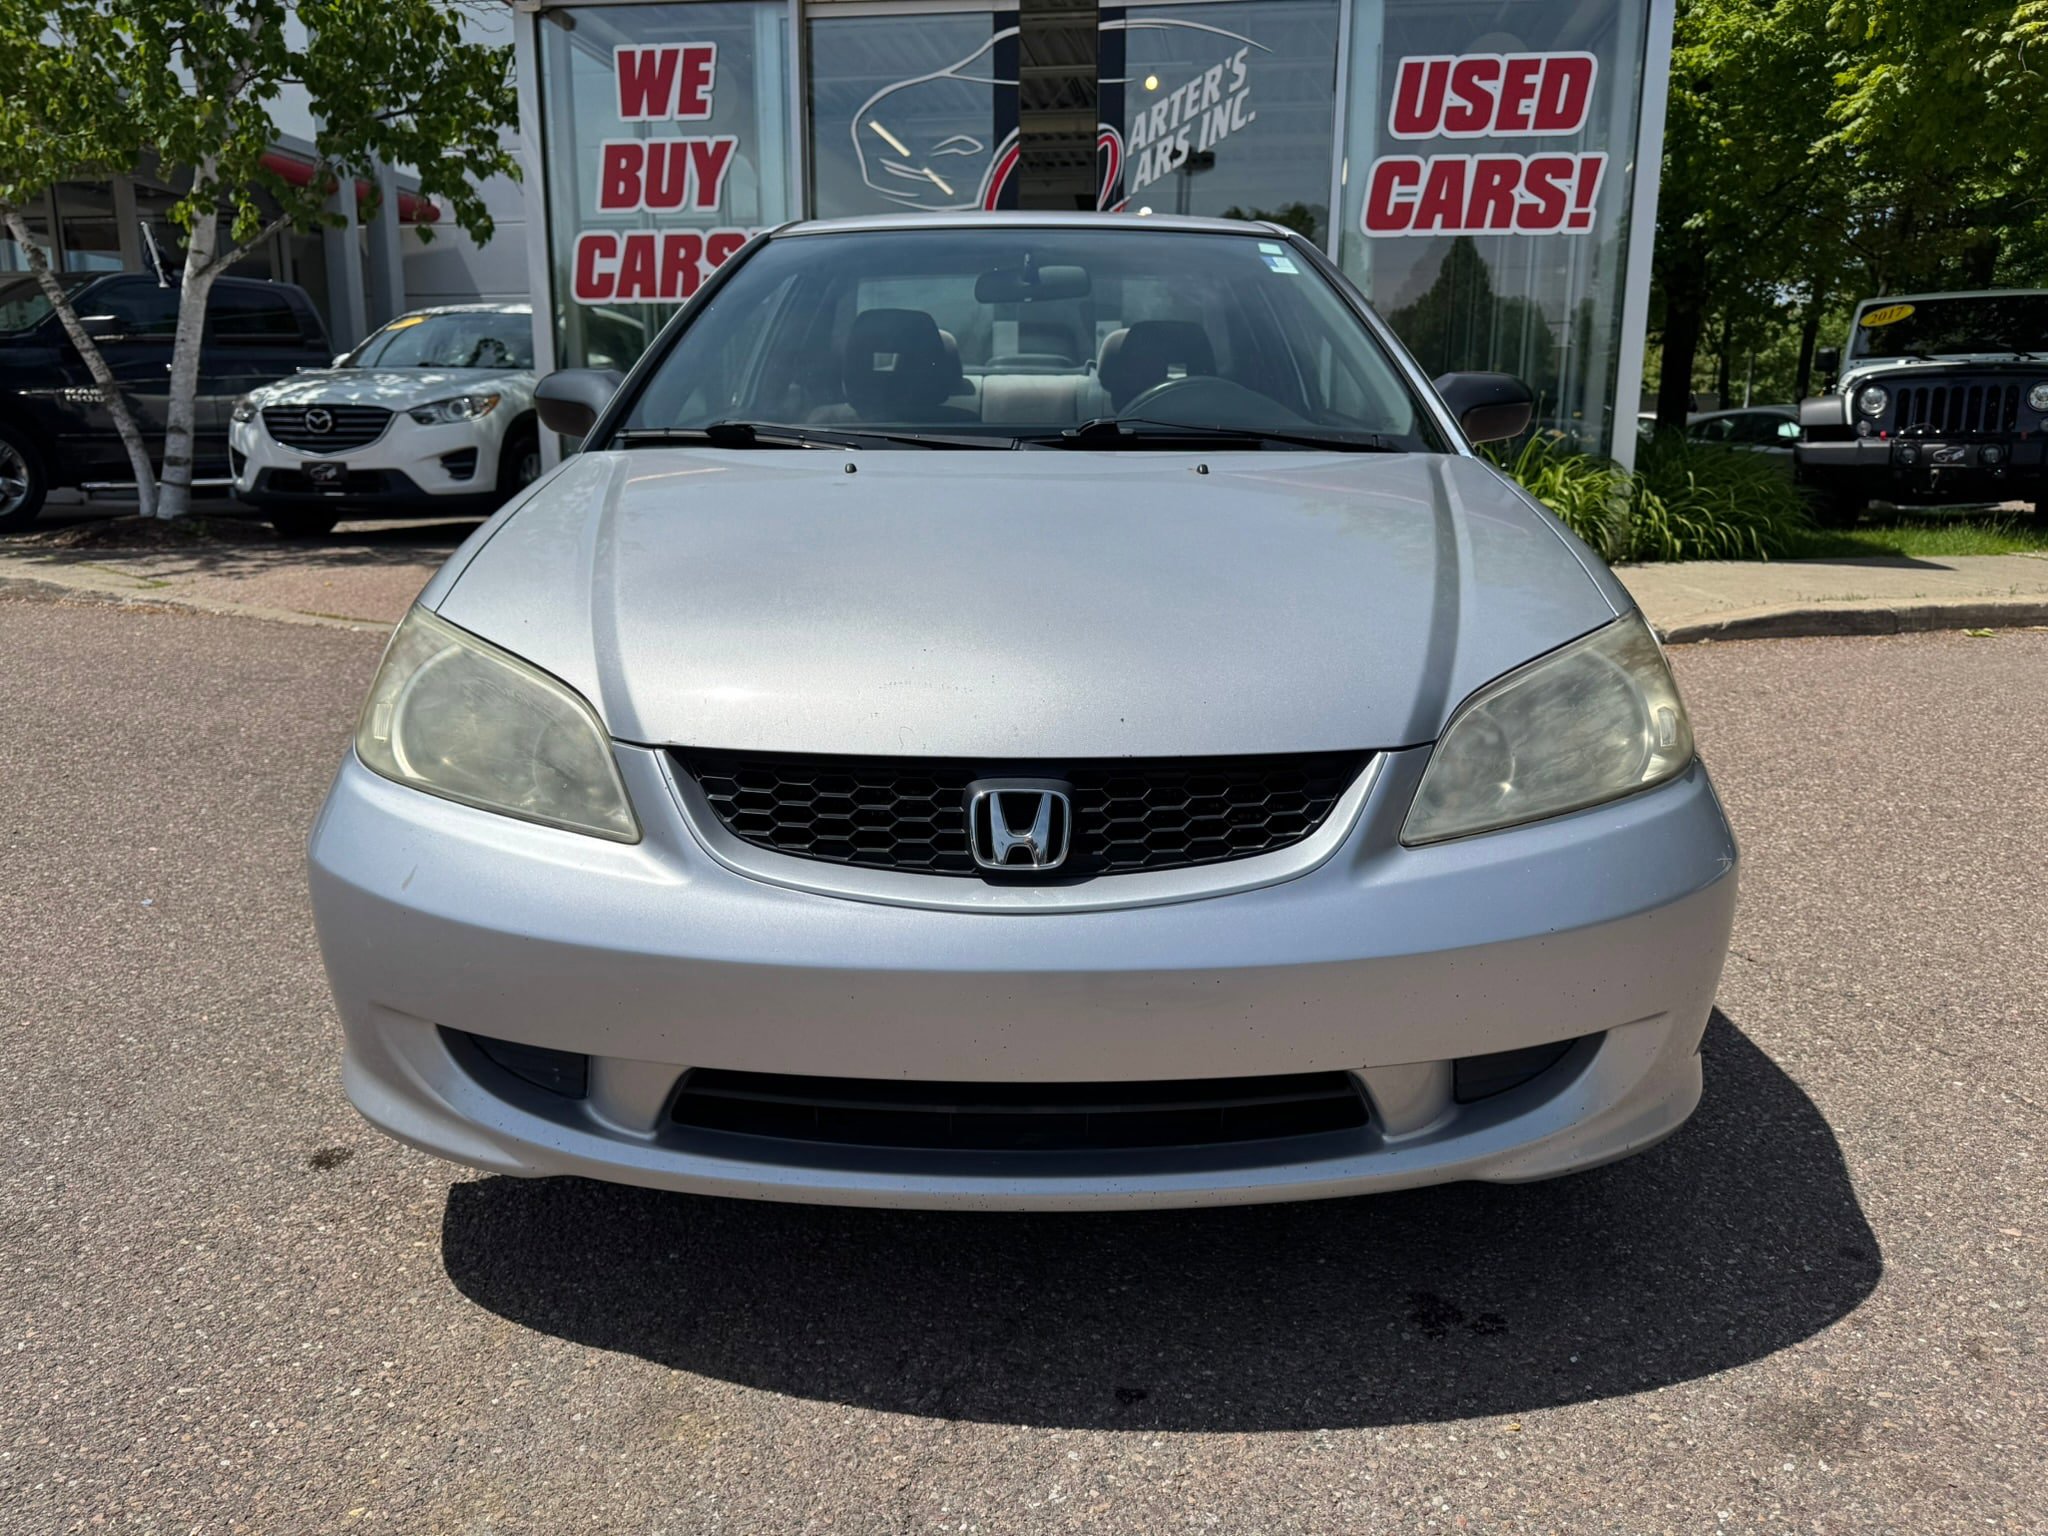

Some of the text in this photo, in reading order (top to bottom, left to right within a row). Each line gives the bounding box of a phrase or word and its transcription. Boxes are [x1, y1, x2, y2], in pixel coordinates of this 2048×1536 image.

[616, 46, 714, 118] WE
[1393, 56, 1594, 135] USED
[1197, 86, 1257, 154] INC.
[600, 139, 734, 210] BUY
[1364, 156, 1604, 233] CARS!
[1869, 306, 1905, 325] 2017
